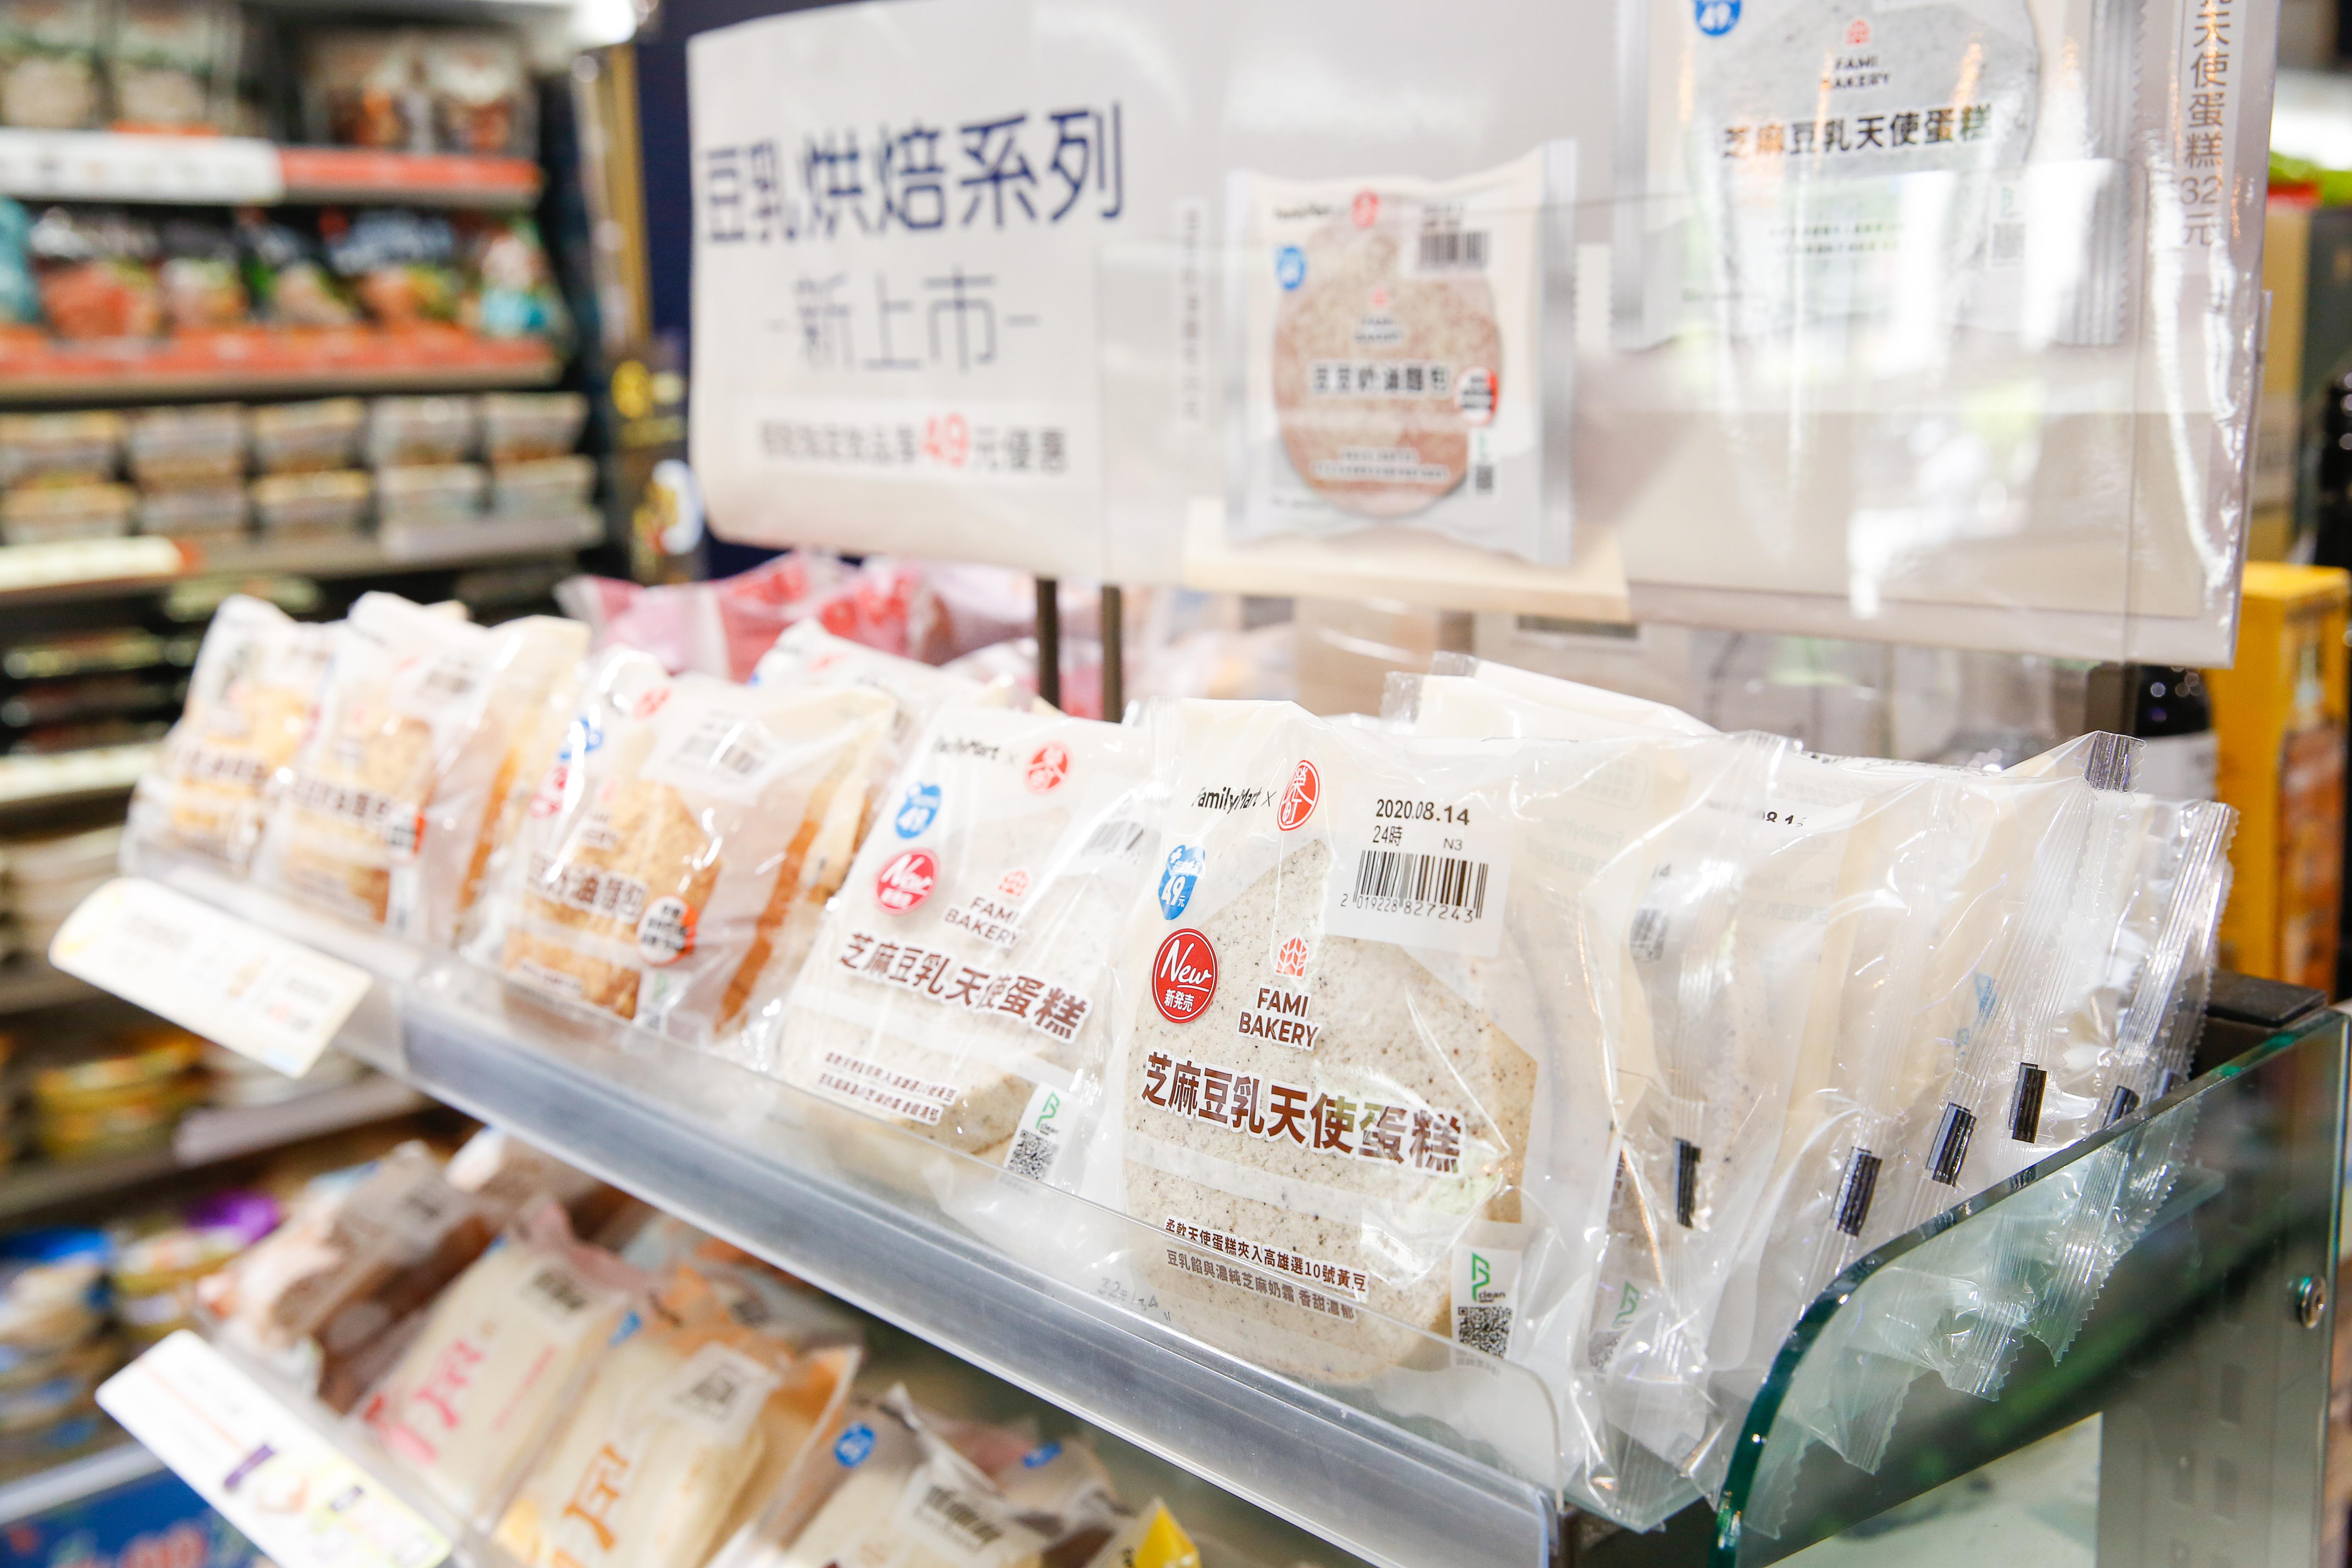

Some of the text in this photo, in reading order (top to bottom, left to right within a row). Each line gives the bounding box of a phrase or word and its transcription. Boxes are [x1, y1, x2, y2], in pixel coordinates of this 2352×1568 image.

[1376, 799, 1470, 826] 2020.08.14
[1372, 825, 1463, 851] 24時 N3
[945, 908, 1017, 945] BAKERY
[970, 897, 1019, 924] FAMI
[1160, 939, 1212, 982] New
[839, 931, 1087, 1040] 芝麻豆乳天使蛋糕
[1163, 988, 1195, 1013] 新発売
[1257, 987, 1309, 1017] FAMI
[1238, 1011, 1319, 1047] BAKERY
[1141, 1051, 1463, 1174] 芝麻豆乳天使蛋糕
